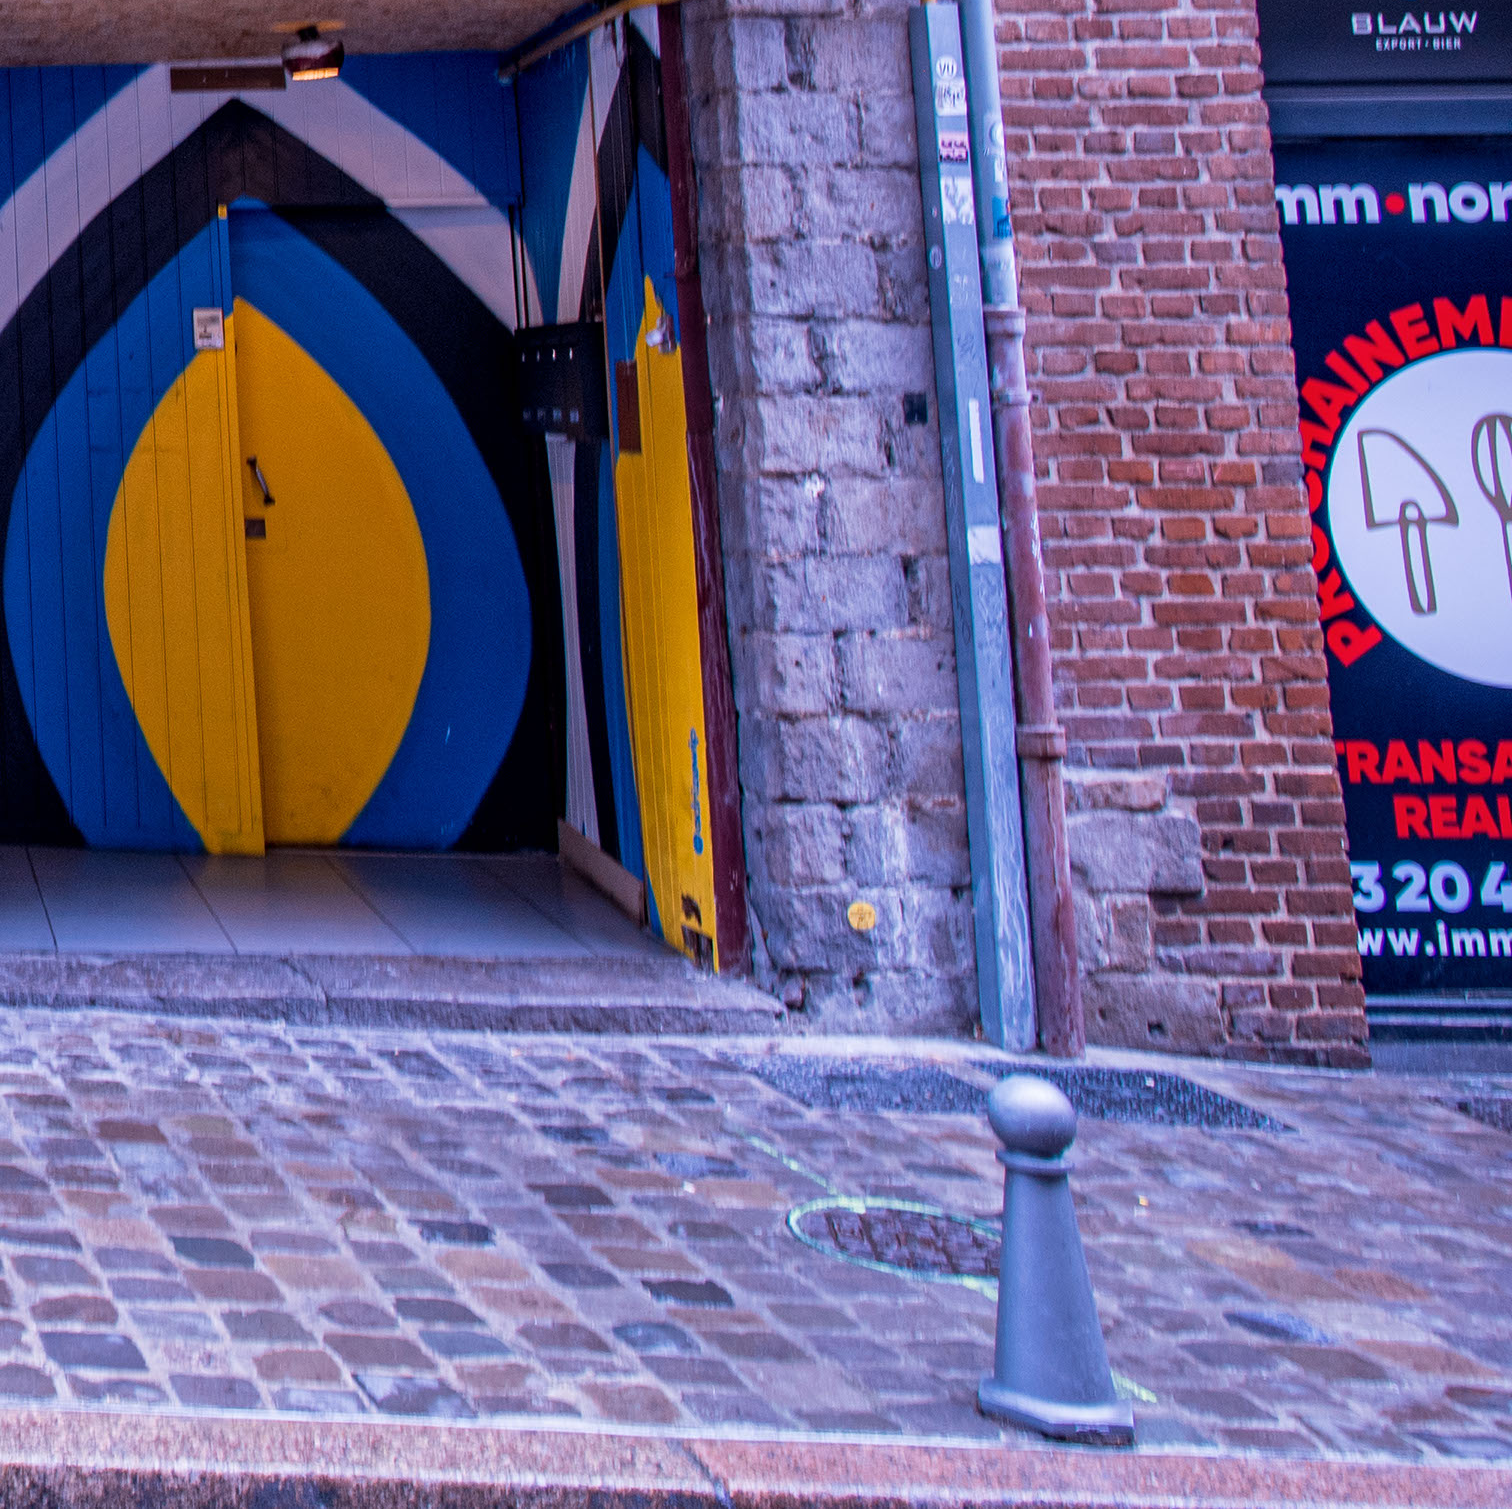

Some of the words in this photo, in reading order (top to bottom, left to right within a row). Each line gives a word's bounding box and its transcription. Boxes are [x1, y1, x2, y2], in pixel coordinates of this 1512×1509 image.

[1351, 11, 1478, 35] BLAUW
[1376, 38, 1422, 52] EXPORT
[1432, 37, 1462, 51] BIER
[1392, 859, 1472, 913] 20
